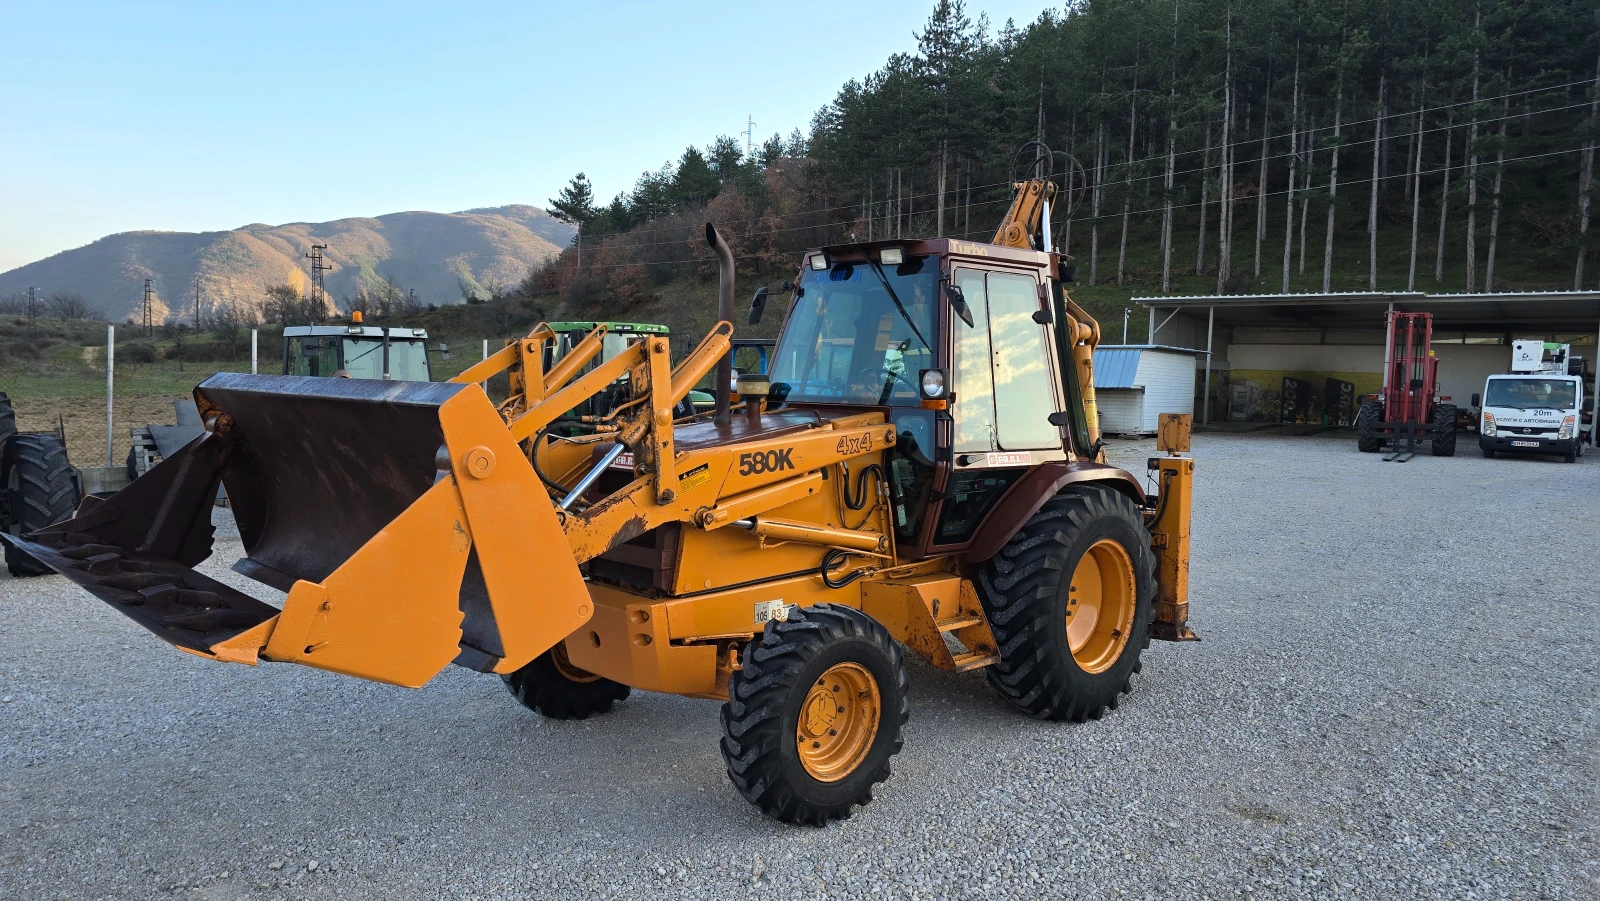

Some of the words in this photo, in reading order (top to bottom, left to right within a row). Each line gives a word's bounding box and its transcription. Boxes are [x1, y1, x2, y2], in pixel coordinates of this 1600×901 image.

[951, 240, 988, 256] Turbo
[836, 432, 872, 455] 4x4
[739, 447, 795, 476] 580K
